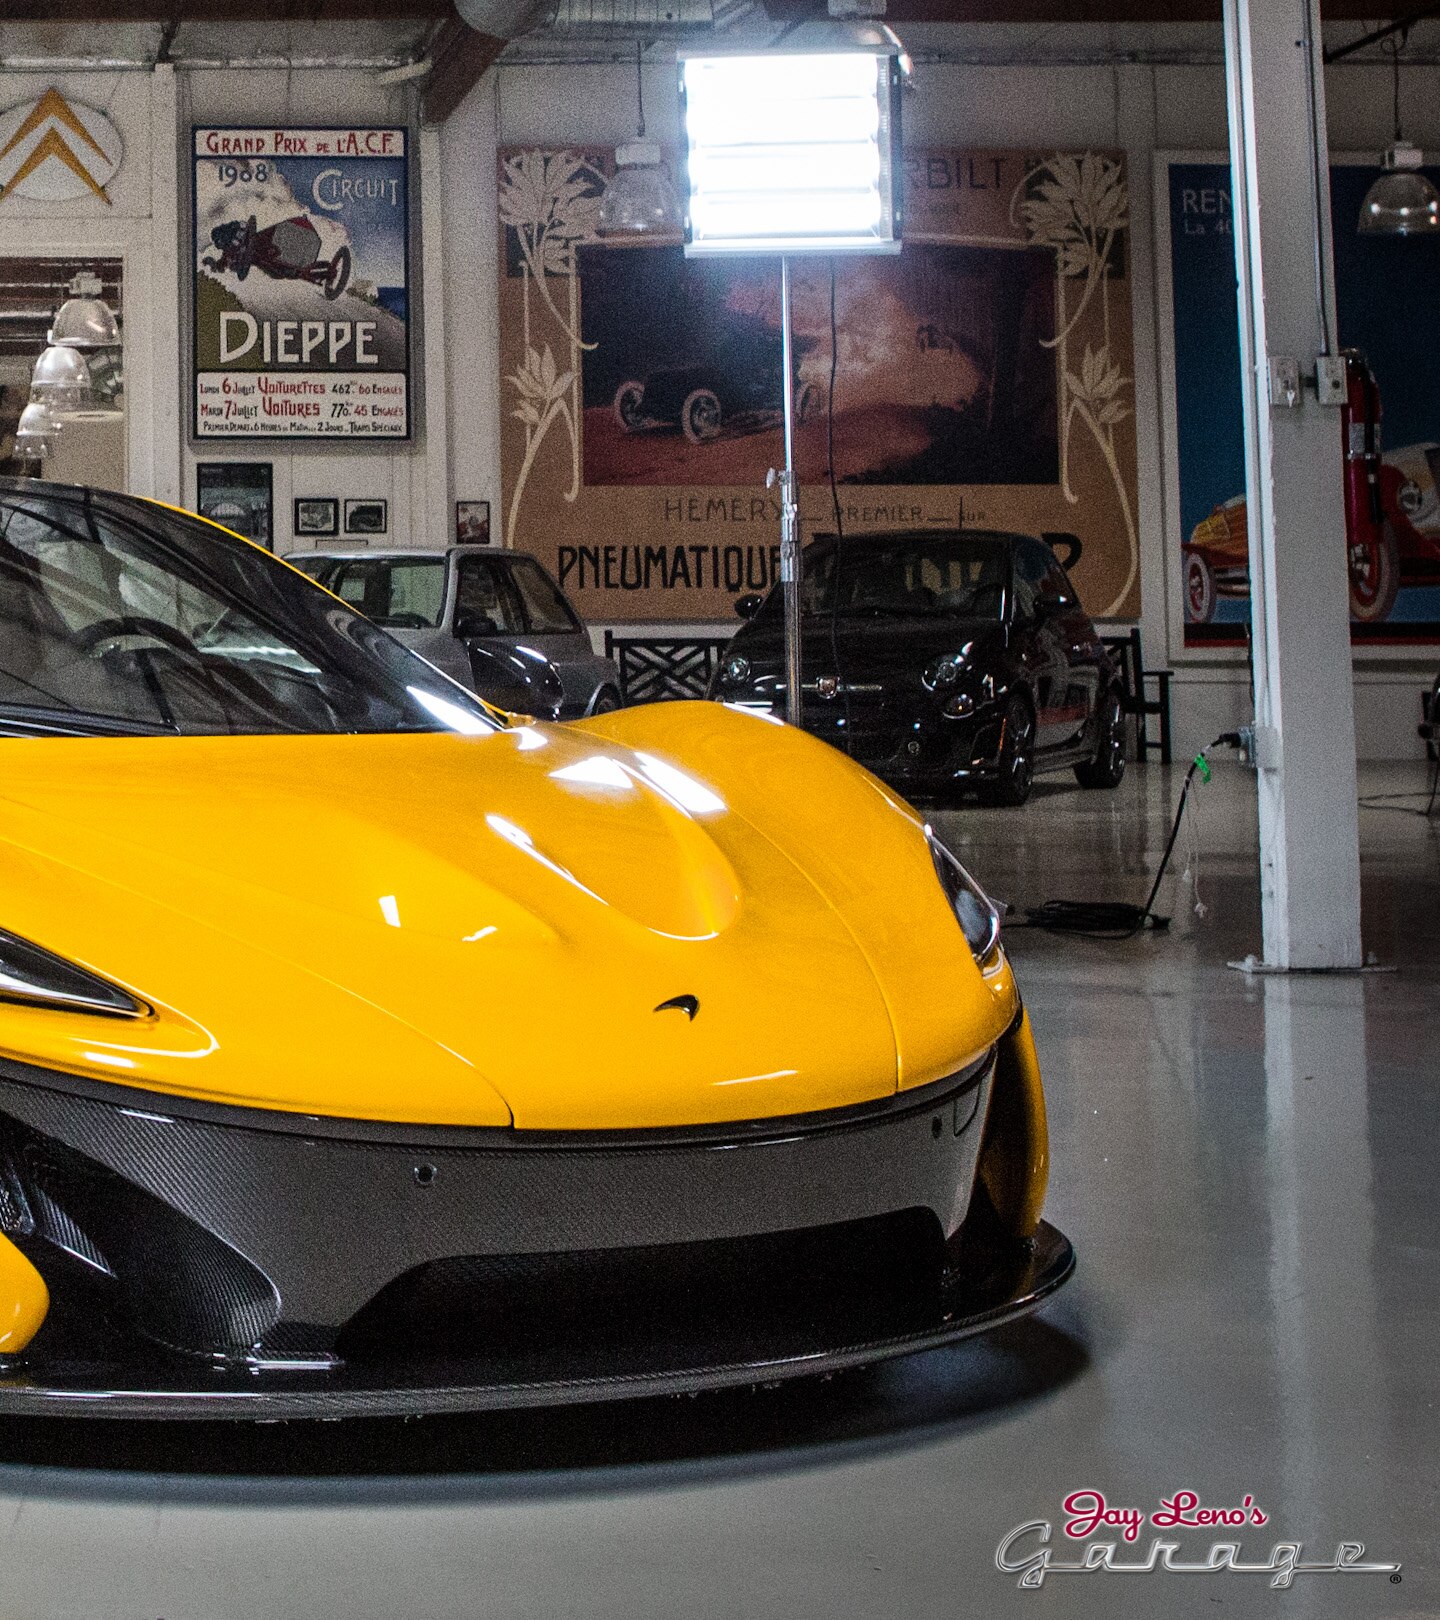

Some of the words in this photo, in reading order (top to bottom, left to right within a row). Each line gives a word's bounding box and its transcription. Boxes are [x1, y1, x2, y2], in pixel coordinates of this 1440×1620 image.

[206, 132, 265, 154] GRAND
[274, 132, 307, 155] PRIX
[218, 163, 268, 187] 1908
[312, 168, 398, 211] CIRCUIT
[1182, 188, 1231, 214] REN
[219, 312, 379, 364] DIEPPE
[222, 377, 231, 394] 6
[257, 376, 326, 395] VOITURETTES
[224, 400, 233, 419] 7
[262, 396, 320, 419] VOITURES
[353, 404, 368, 416] 45
[317, 421, 324, 432] 2
[831, 506, 923, 522] PREMIER
